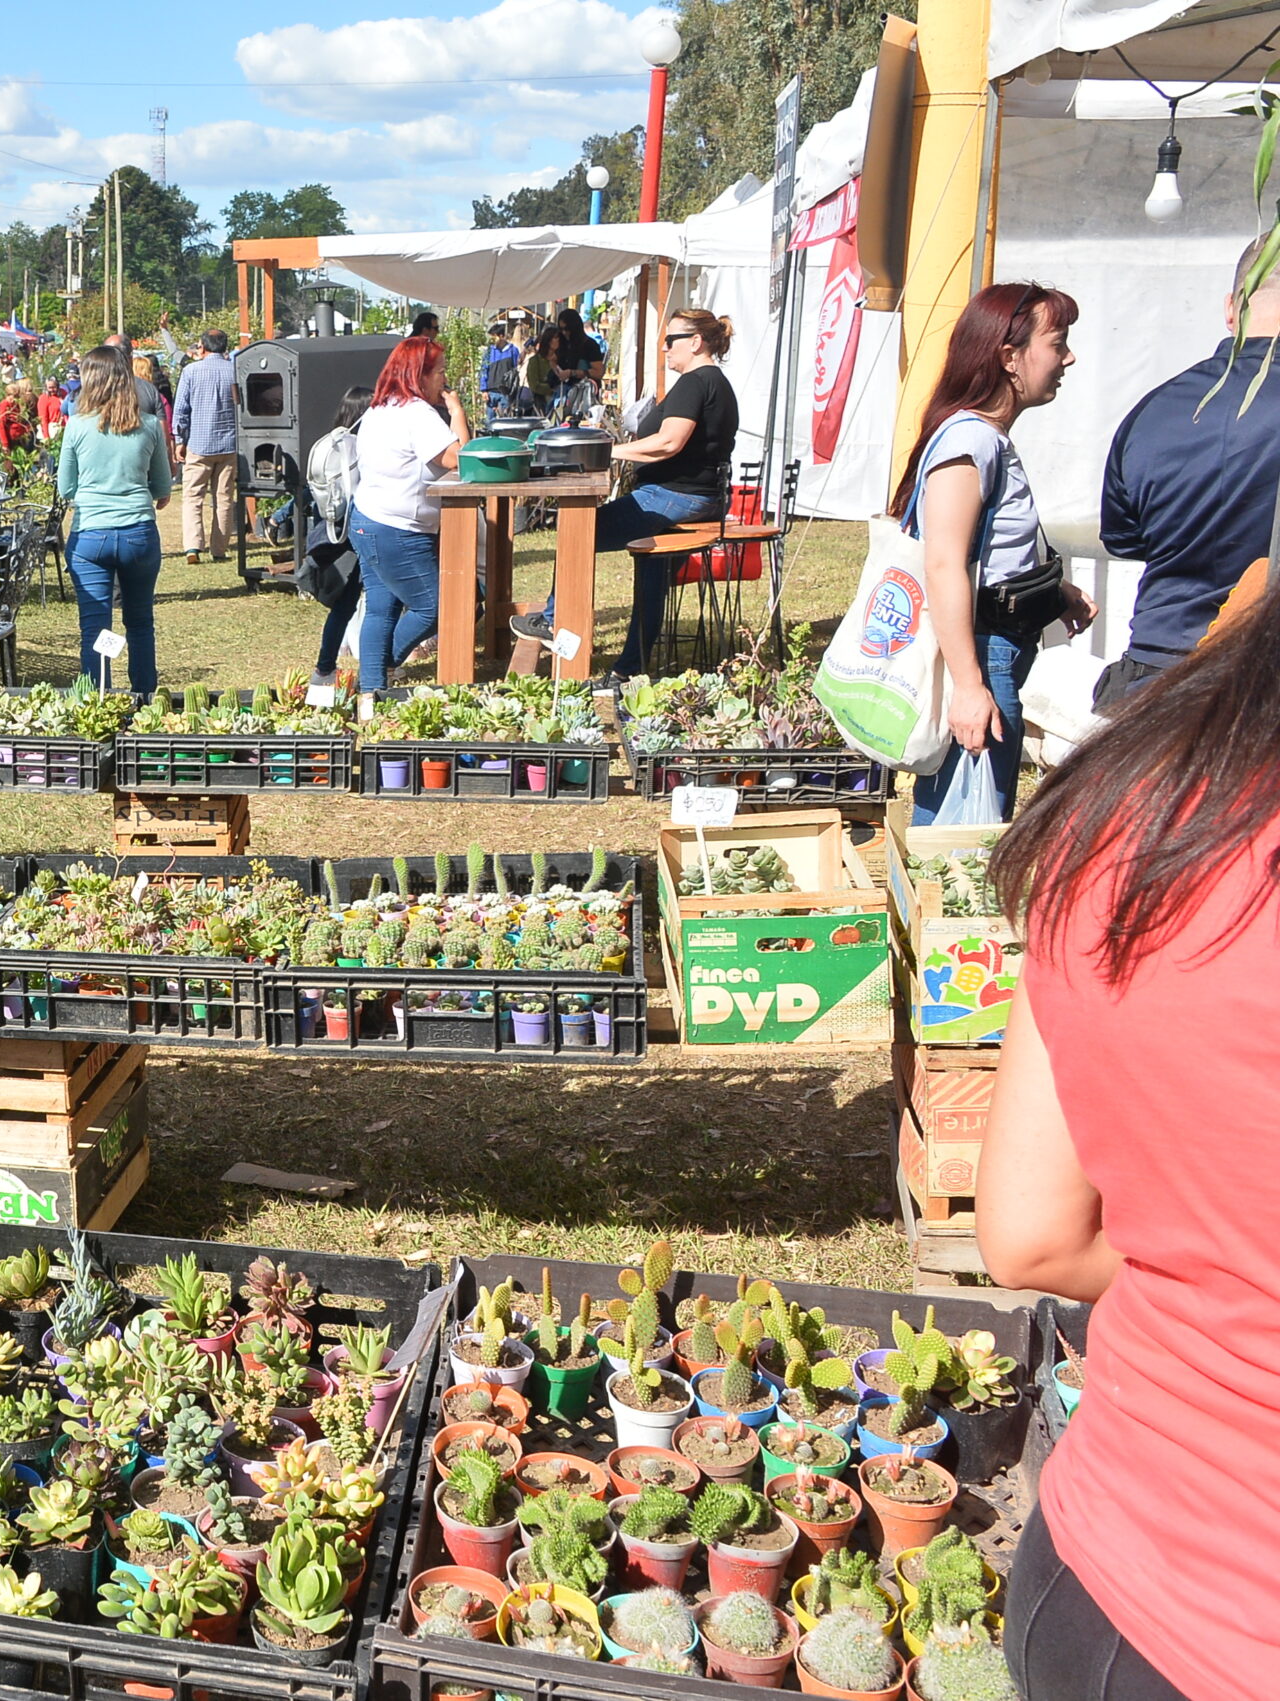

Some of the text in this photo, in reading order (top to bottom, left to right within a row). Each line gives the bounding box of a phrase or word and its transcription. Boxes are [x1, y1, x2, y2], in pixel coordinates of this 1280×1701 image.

[880, 588, 895, 610] EL
[113, 804, 219, 827] Fredy
[690, 983, 820, 1030] DyD
